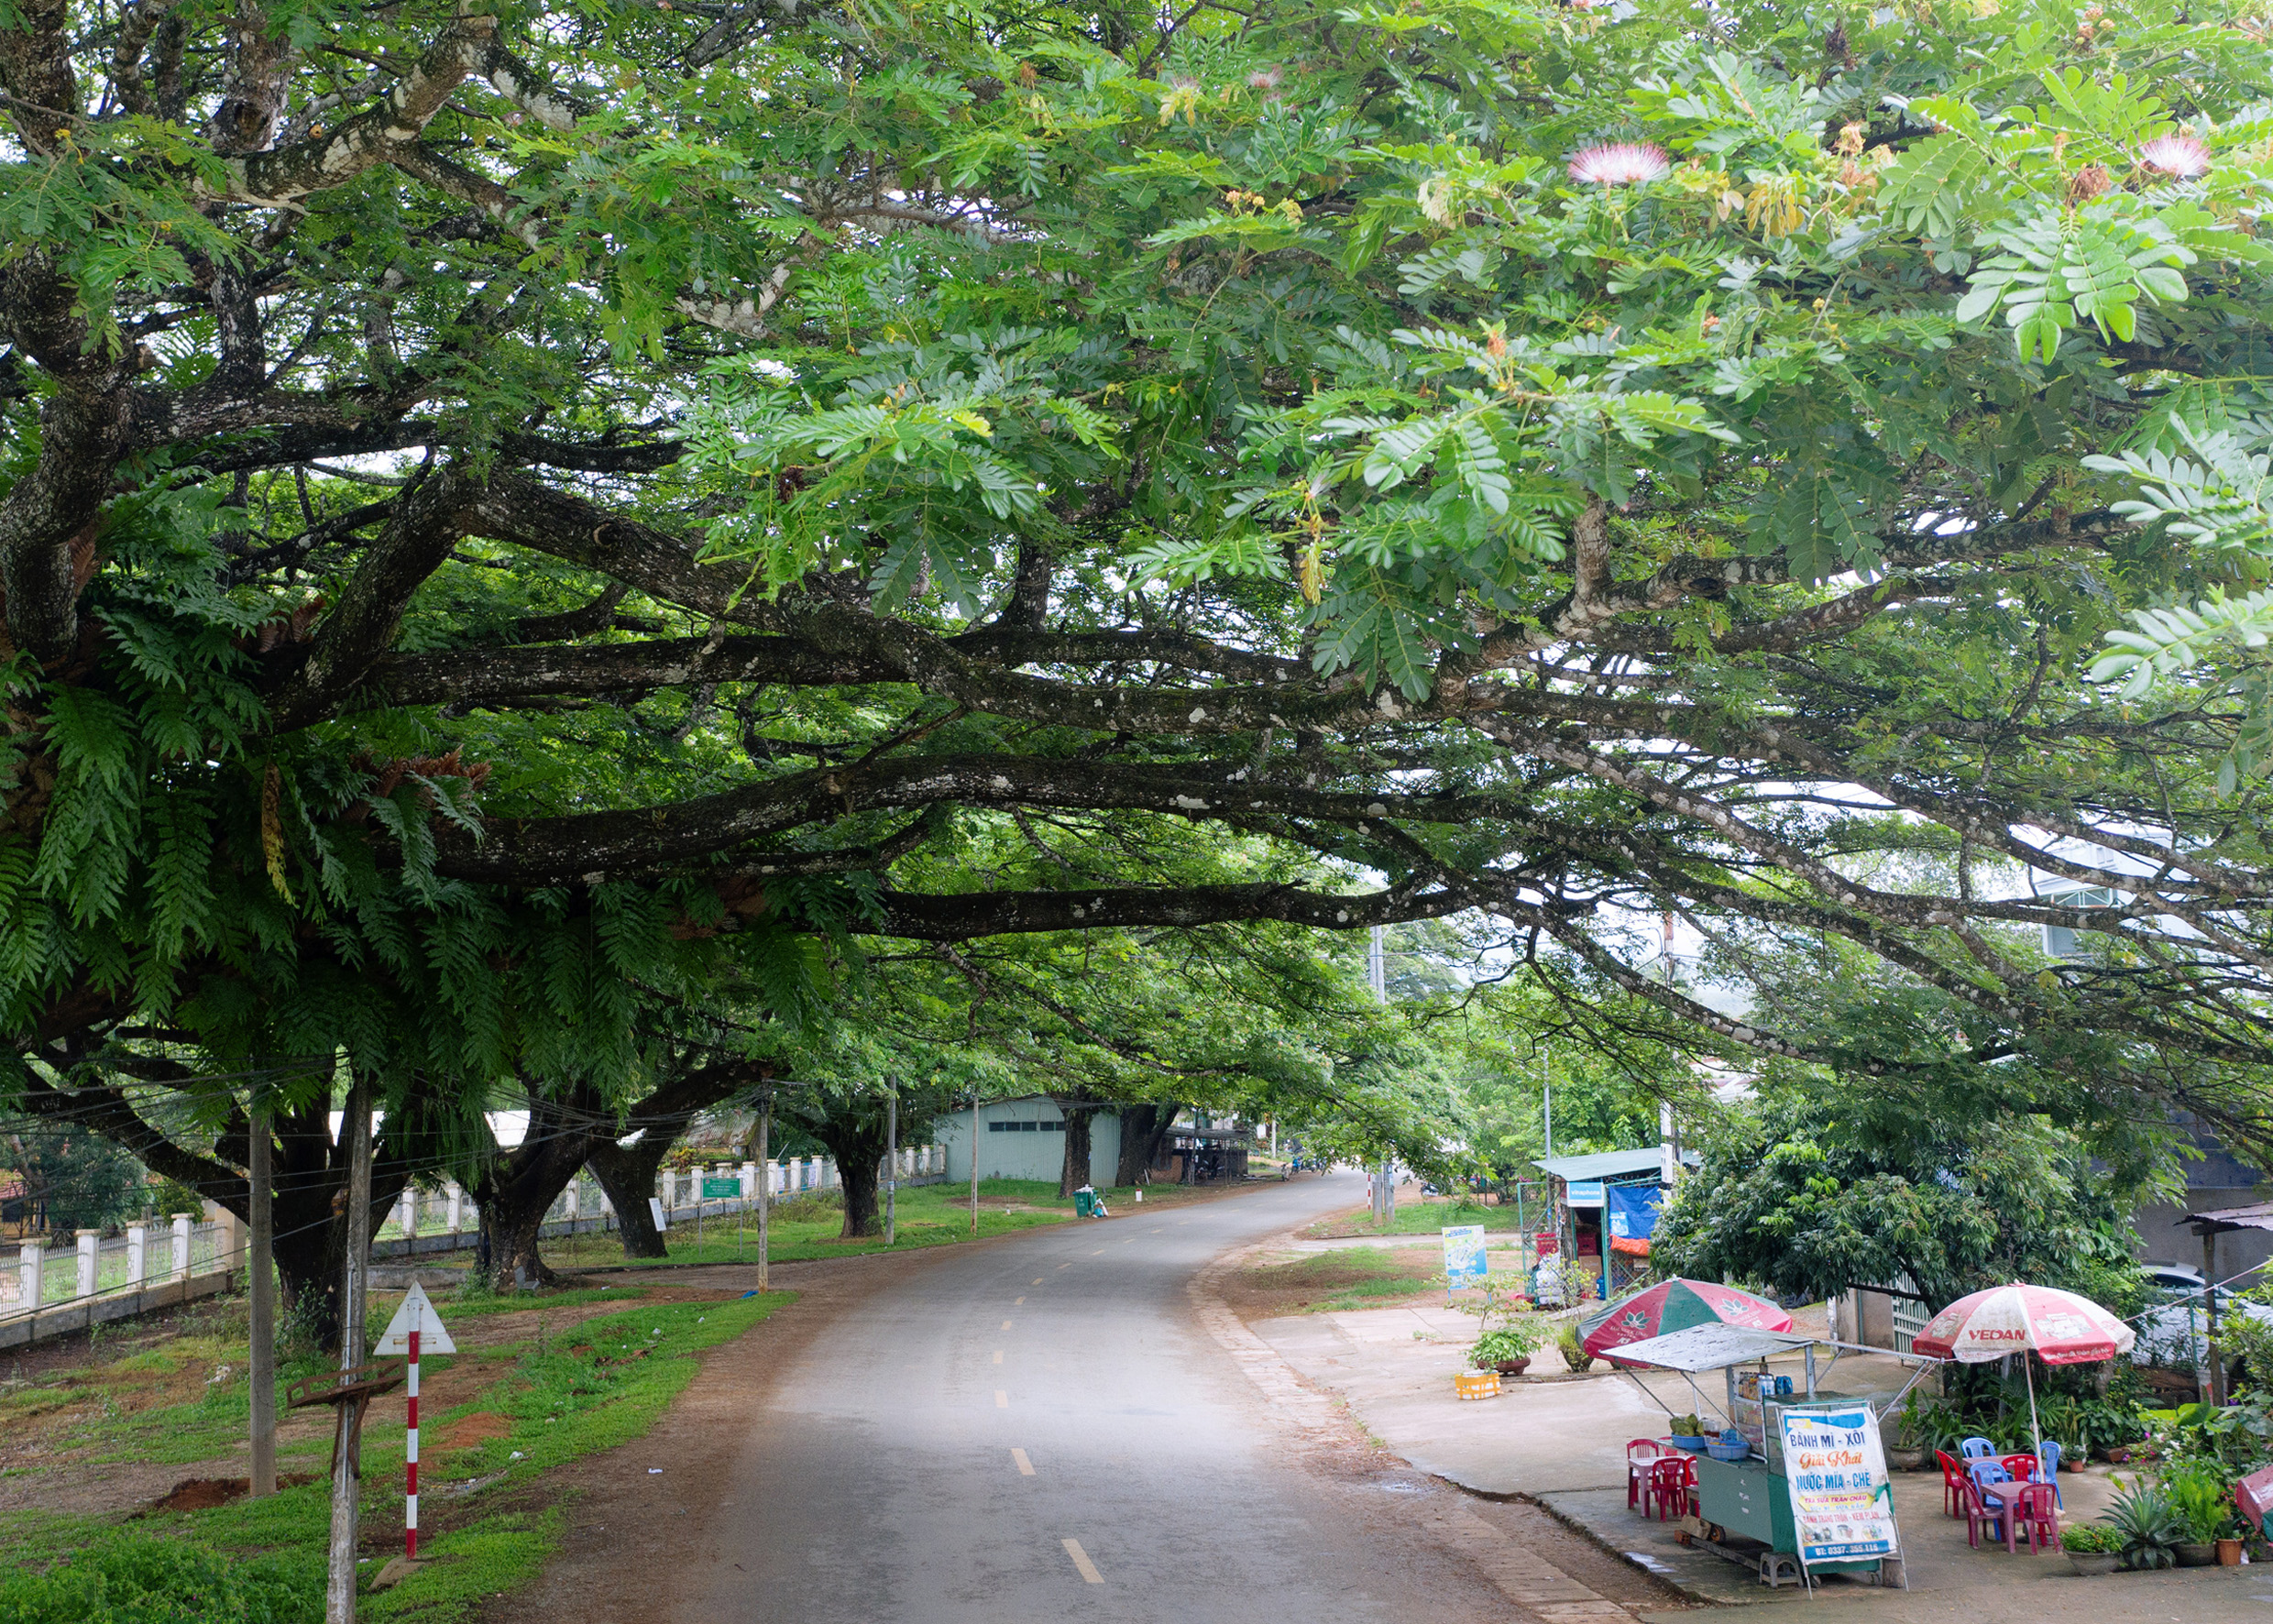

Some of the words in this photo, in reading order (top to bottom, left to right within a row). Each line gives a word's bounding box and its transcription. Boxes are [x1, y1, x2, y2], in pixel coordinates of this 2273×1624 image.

[1969, 1329, 2026, 1341] VEDAN
[1844, 1430, 1865, 1446] XÔI
[1852, 1469, 1872, 1487] CHÈ
